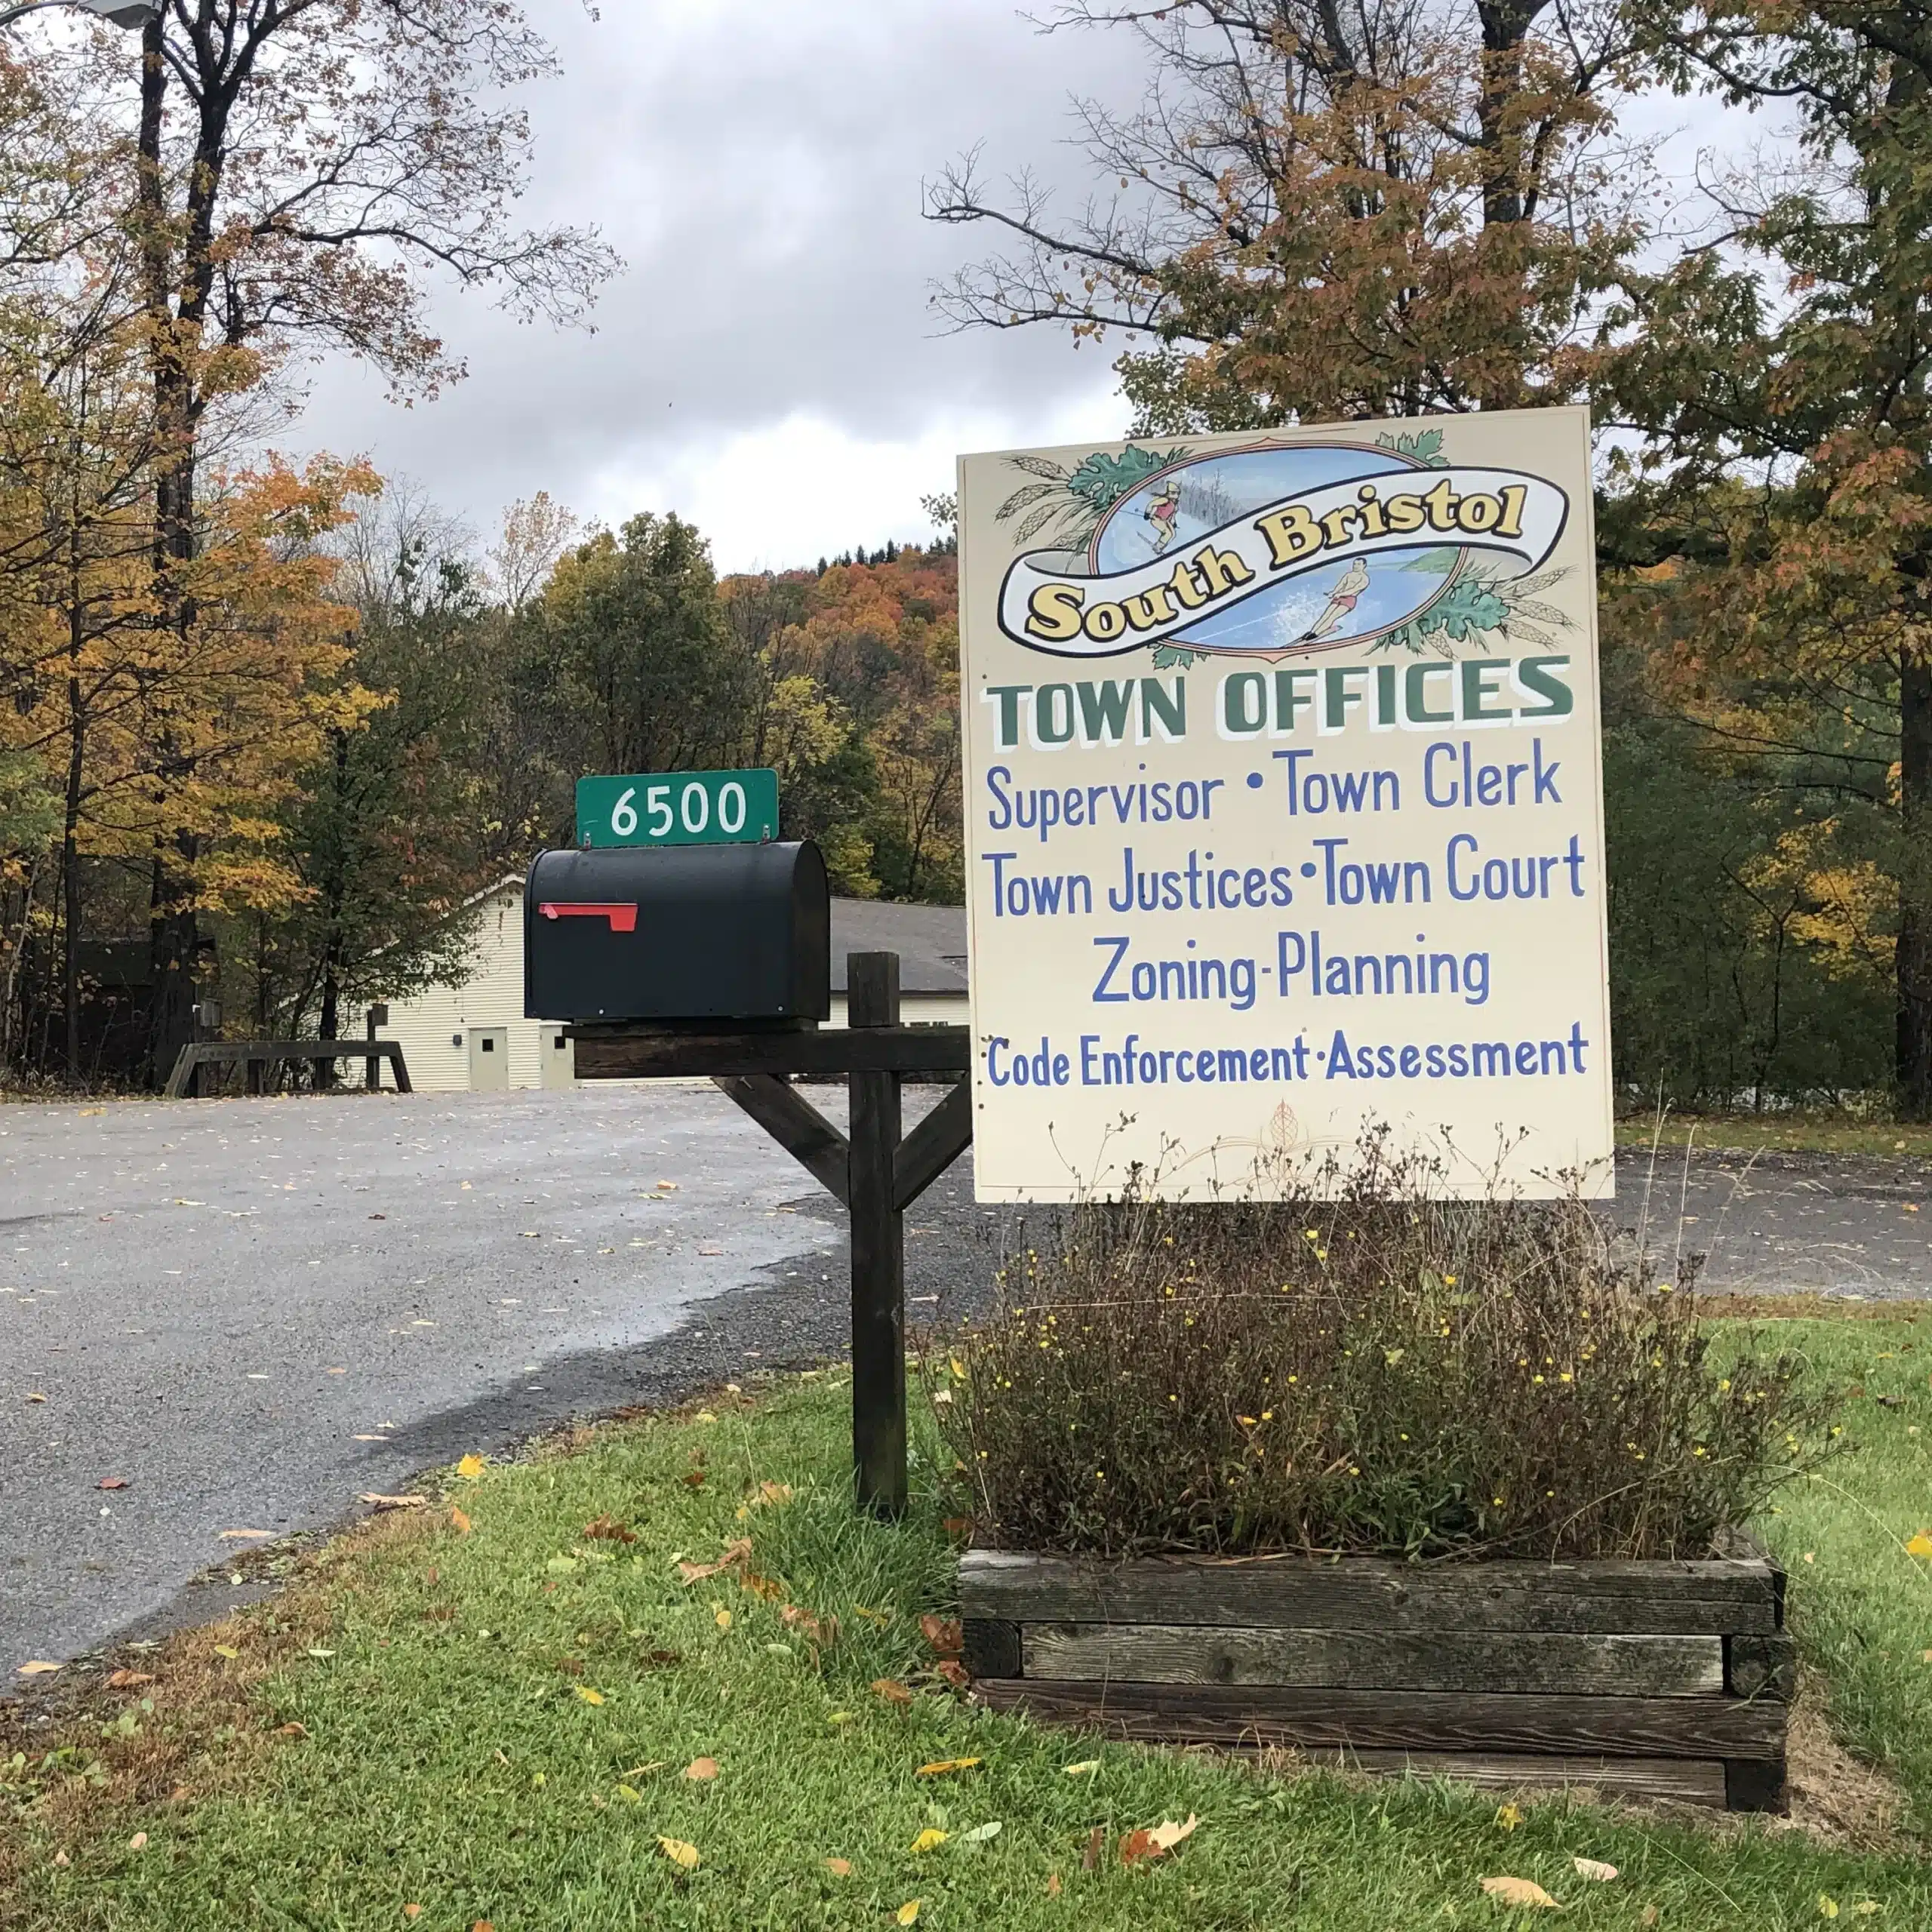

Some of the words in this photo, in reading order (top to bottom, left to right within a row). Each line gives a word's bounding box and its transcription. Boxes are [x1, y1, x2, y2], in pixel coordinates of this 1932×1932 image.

[1024, 545, 1256, 645] South
[1254, 478, 1528, 571] Bristol
[983, 675, 1186, 749] TOWN
[1221, 654, 1573, 734] OFFICES
[611, 782, 747, 837] 6500
[987, 763, 1224, 842] Supervisor
[1272, 748, 1400, 816] Town
[1424, 737, 1563, 808] Clerk
[981, 852, 1093, 917] Town
[1447, 833, 1586, 900] Court
[987, 1037, 1070, 1087] Code
[1080, 1035, 1309, 1087] Enforcement
[1326, 1021, 1589, 1080] Assessment
